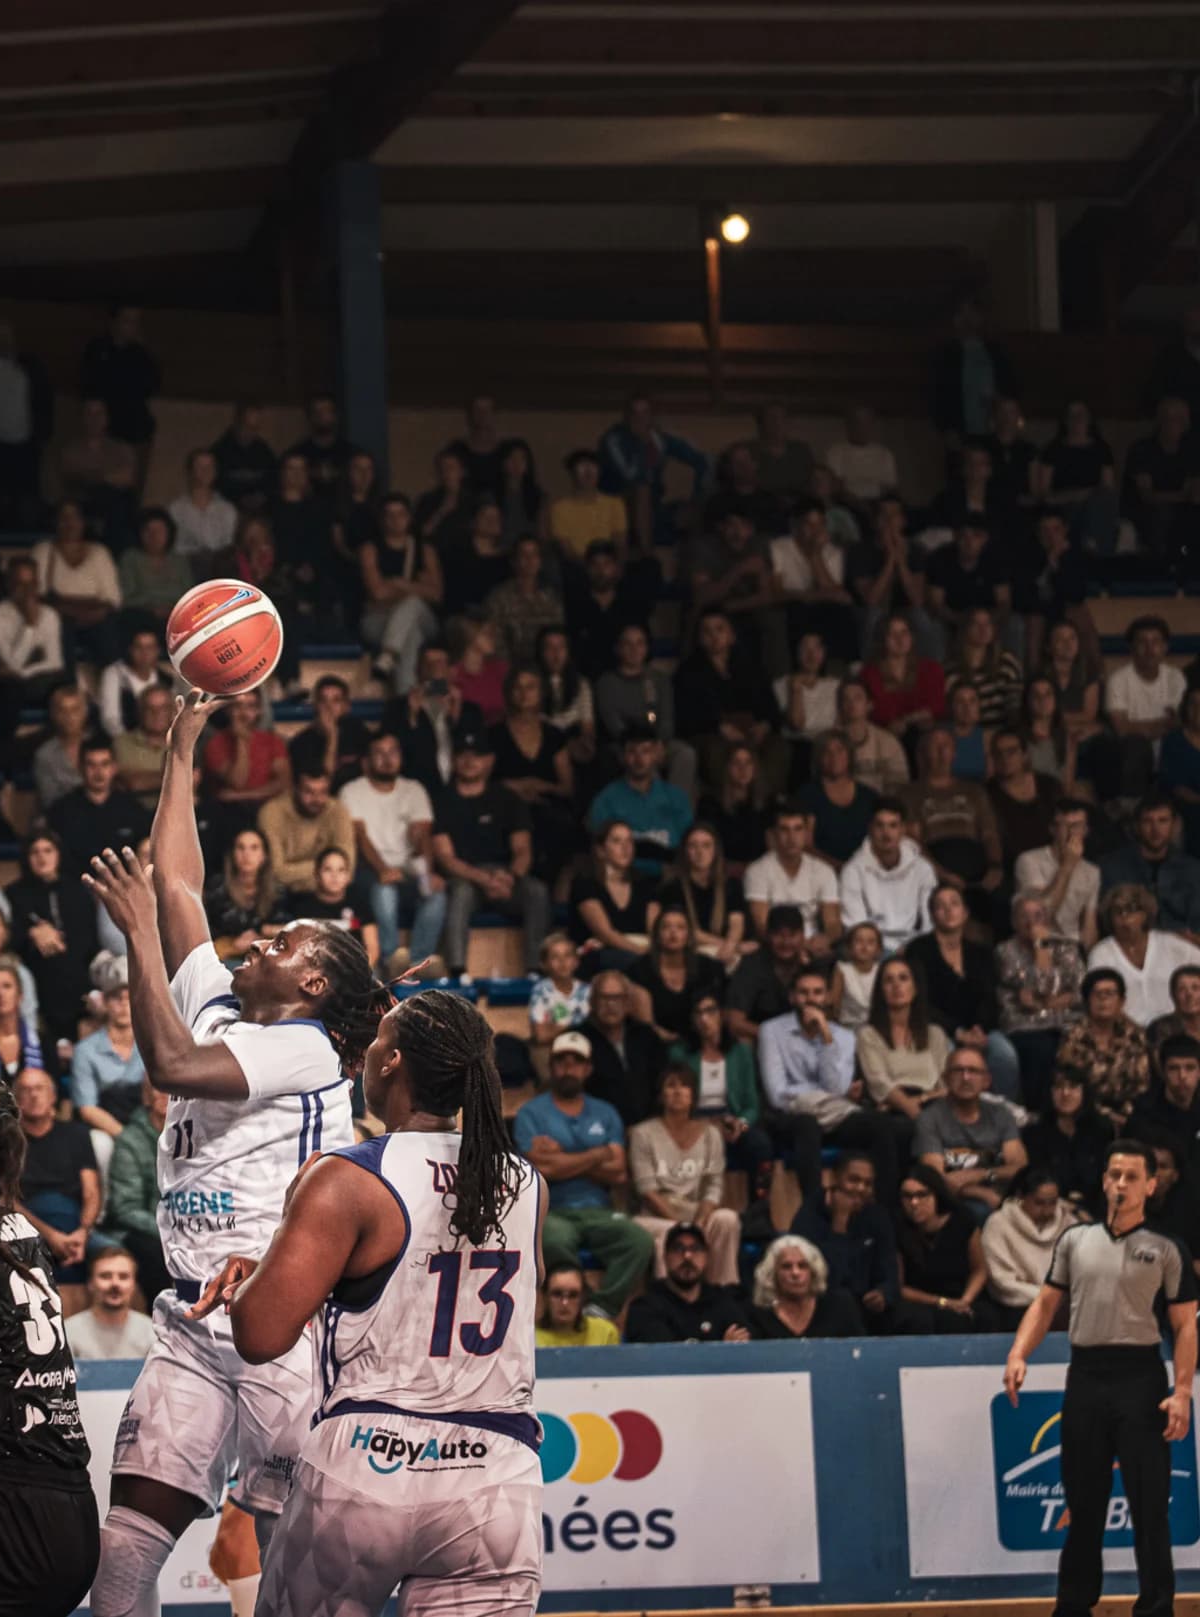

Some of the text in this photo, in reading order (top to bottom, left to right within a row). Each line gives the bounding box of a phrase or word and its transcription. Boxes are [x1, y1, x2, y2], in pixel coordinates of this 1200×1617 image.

[428, 1250, 522, 1358] 13
[350, 1424, 488, 1466] HapyAuto
[1005, 1483, 1049, 1497] Mairie
